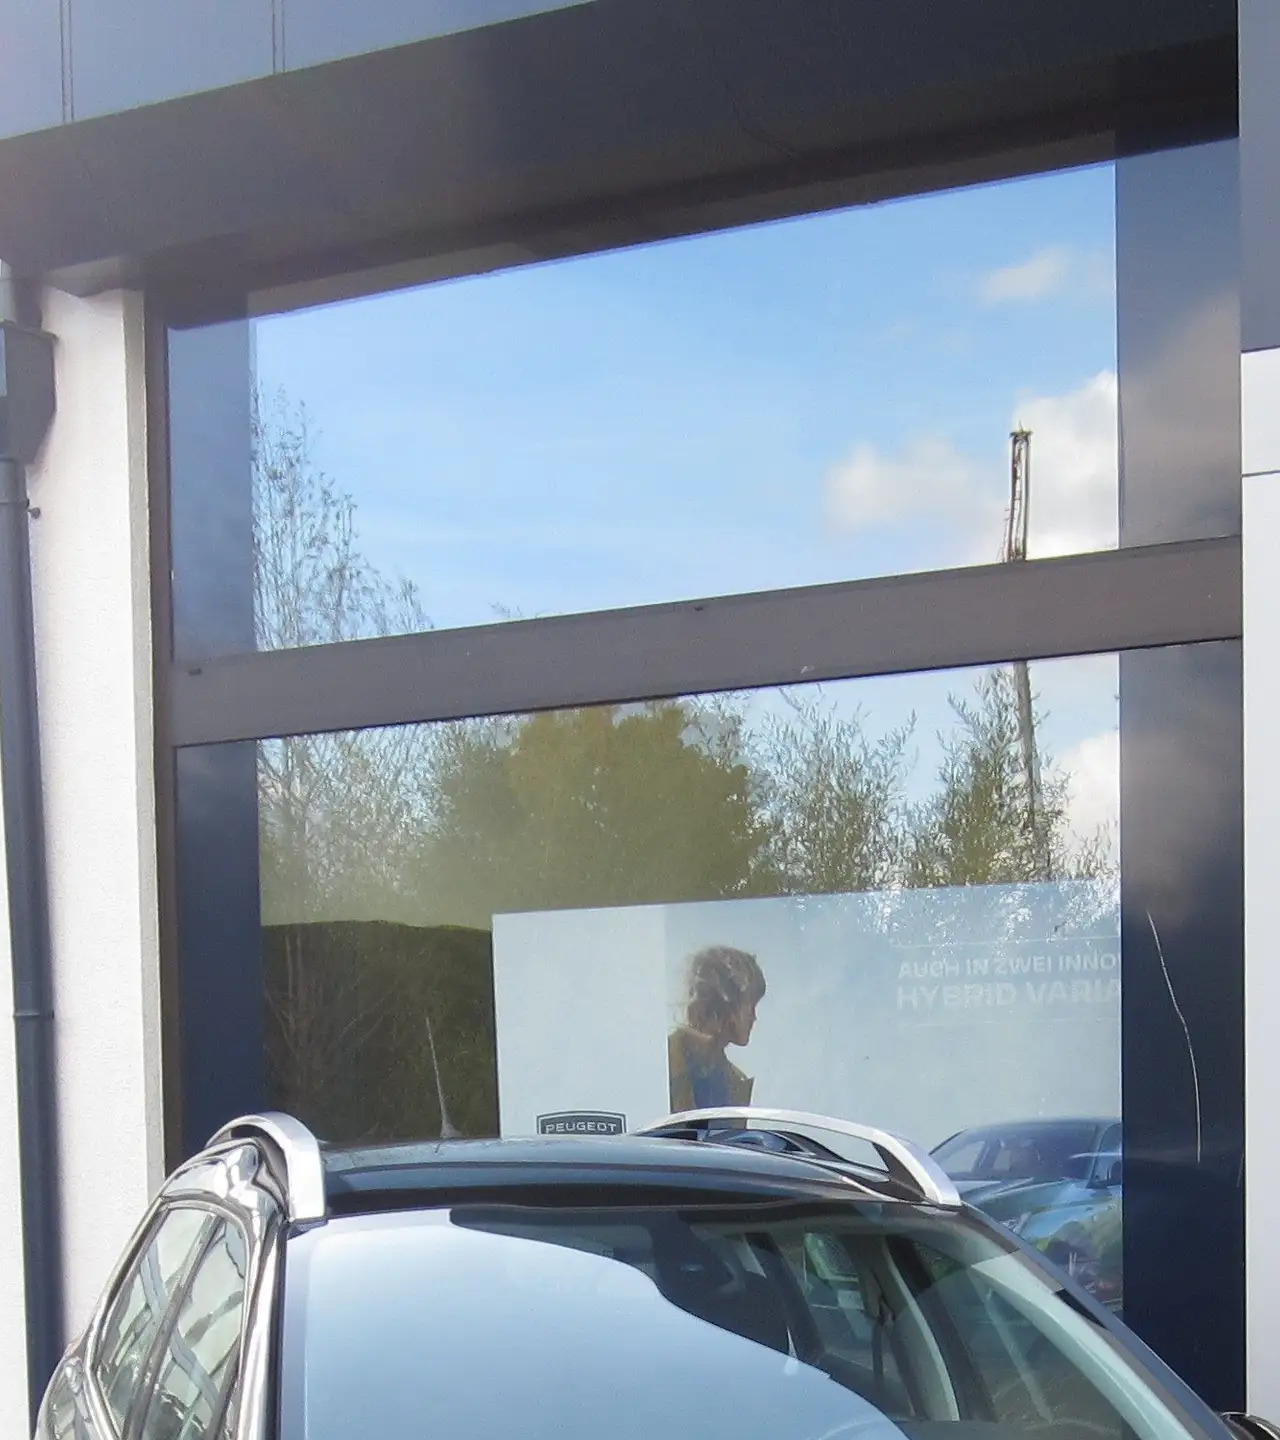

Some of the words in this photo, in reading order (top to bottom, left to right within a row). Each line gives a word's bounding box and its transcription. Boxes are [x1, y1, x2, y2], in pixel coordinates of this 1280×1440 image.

[898, 958, 960, 979] AUCH
[966, 957, 988, 977] IN
[994, 955, 1053, 975] ZWEI
[1058, 952, 1121, 972] INNO
[896, 981, 1017, 1010] HYBRID
[545, 1121, 617, 1134] PEUGEOT
